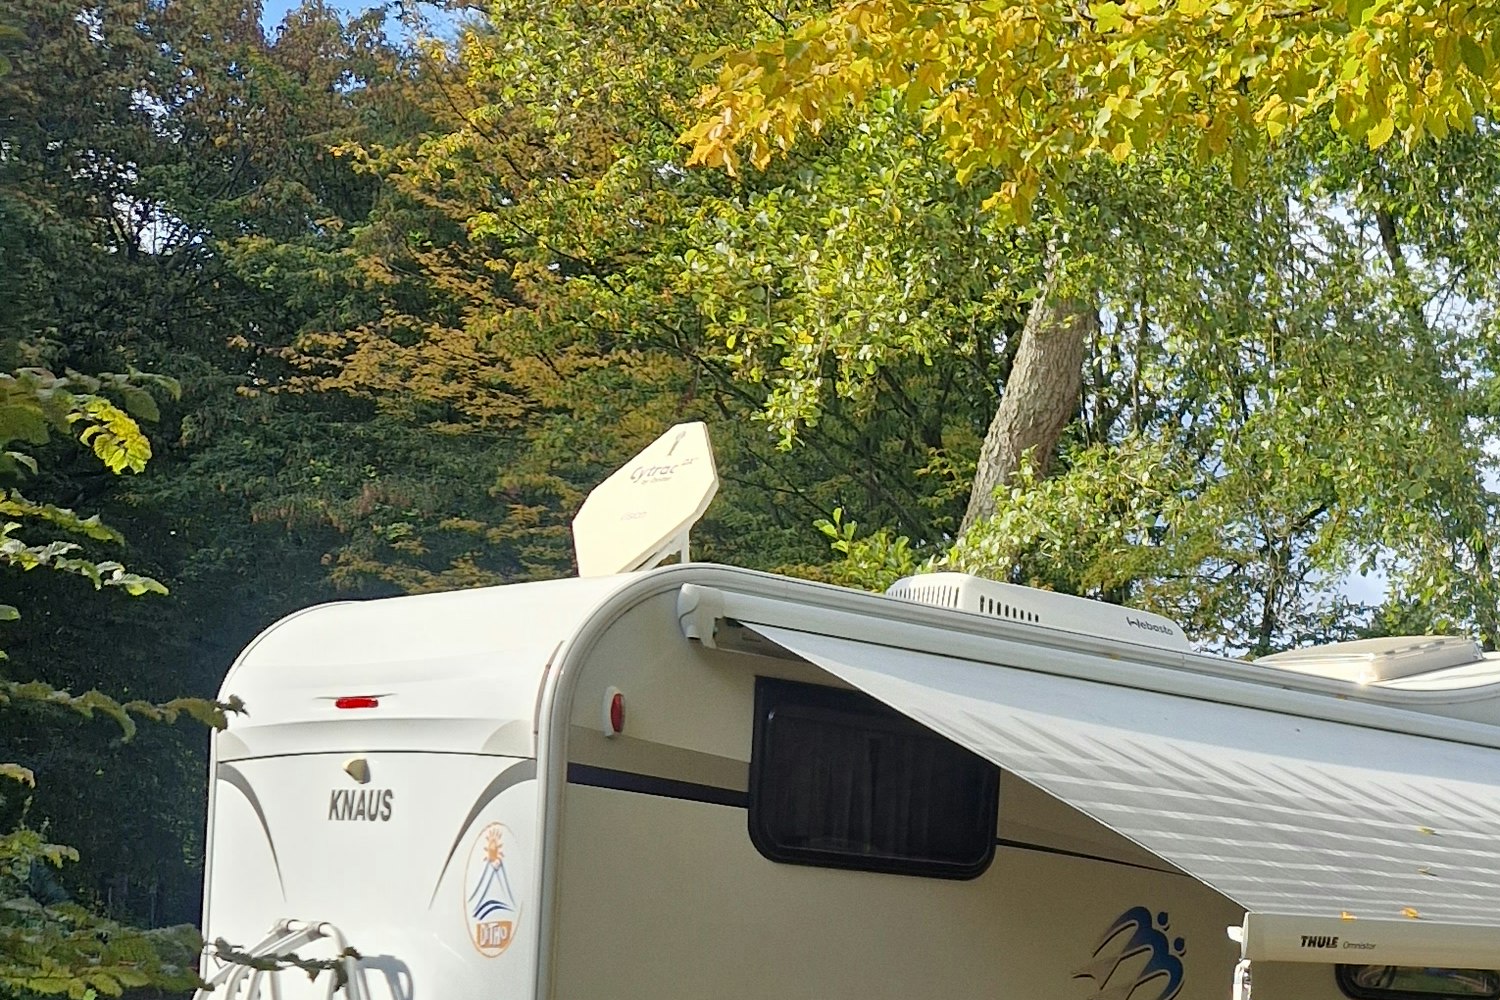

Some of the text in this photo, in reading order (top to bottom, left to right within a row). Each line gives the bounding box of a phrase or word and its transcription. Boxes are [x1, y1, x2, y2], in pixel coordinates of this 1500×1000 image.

[1126, 616, 1174, 636] Webasto
[328, 789, 394, 822] KNAUS
[1300, 935, 1339, 949] THULE
